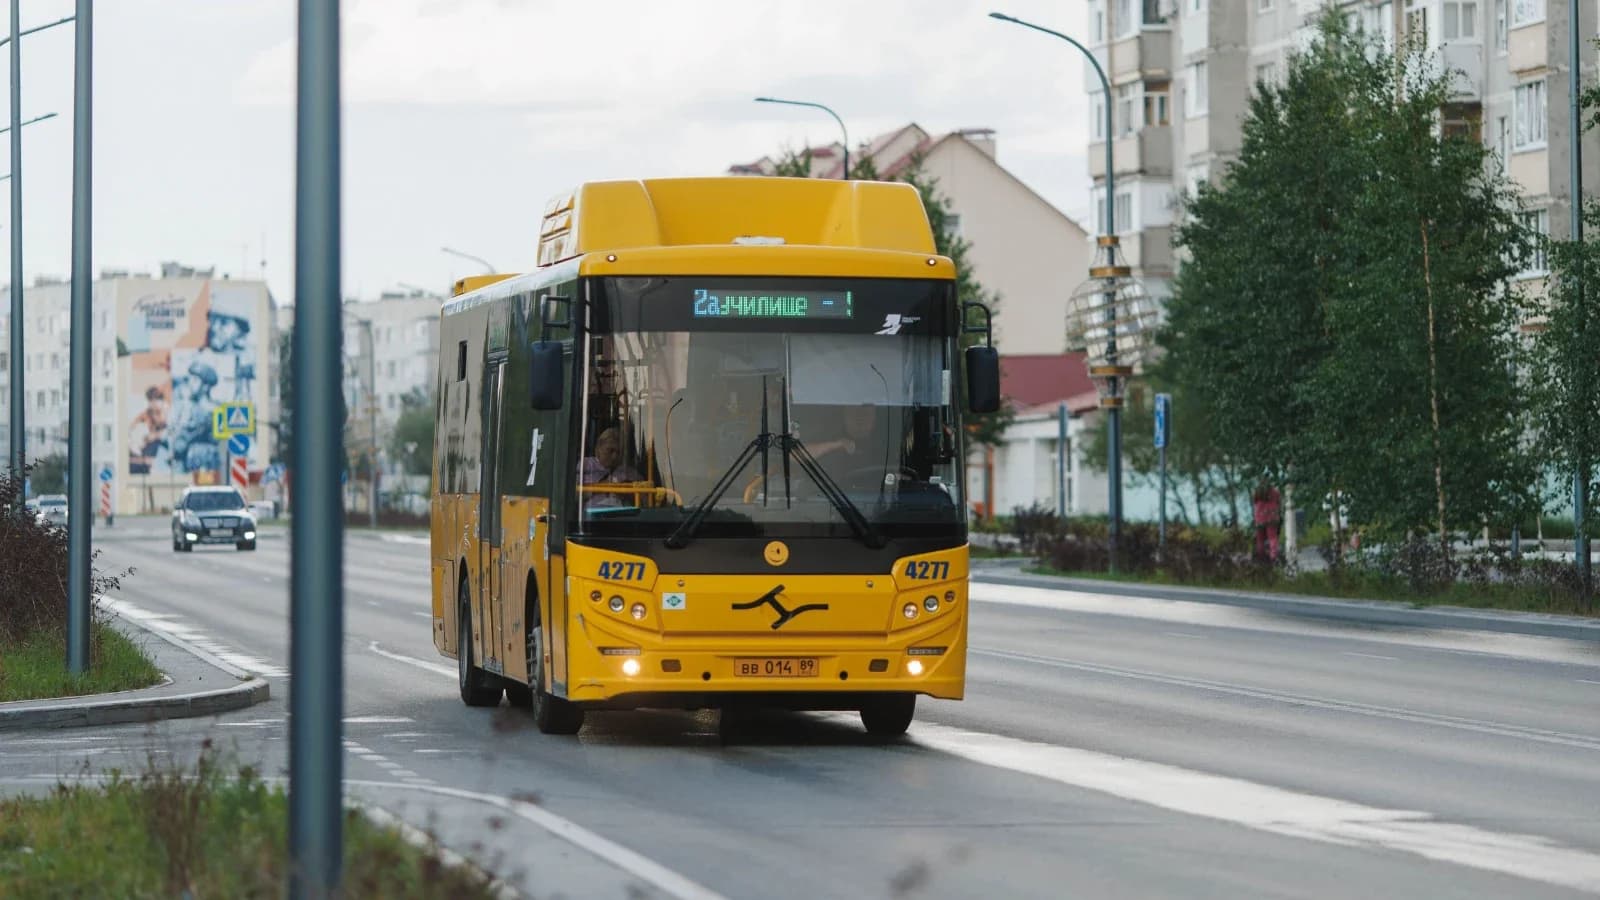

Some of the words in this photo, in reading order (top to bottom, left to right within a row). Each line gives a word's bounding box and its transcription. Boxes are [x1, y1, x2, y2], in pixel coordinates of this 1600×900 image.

[598, 560, 646, 581] 4277
[905, 560, 950, 580] 4277
[765, 660, 792, 674] 014
[800, 660, 814, 670] 89
